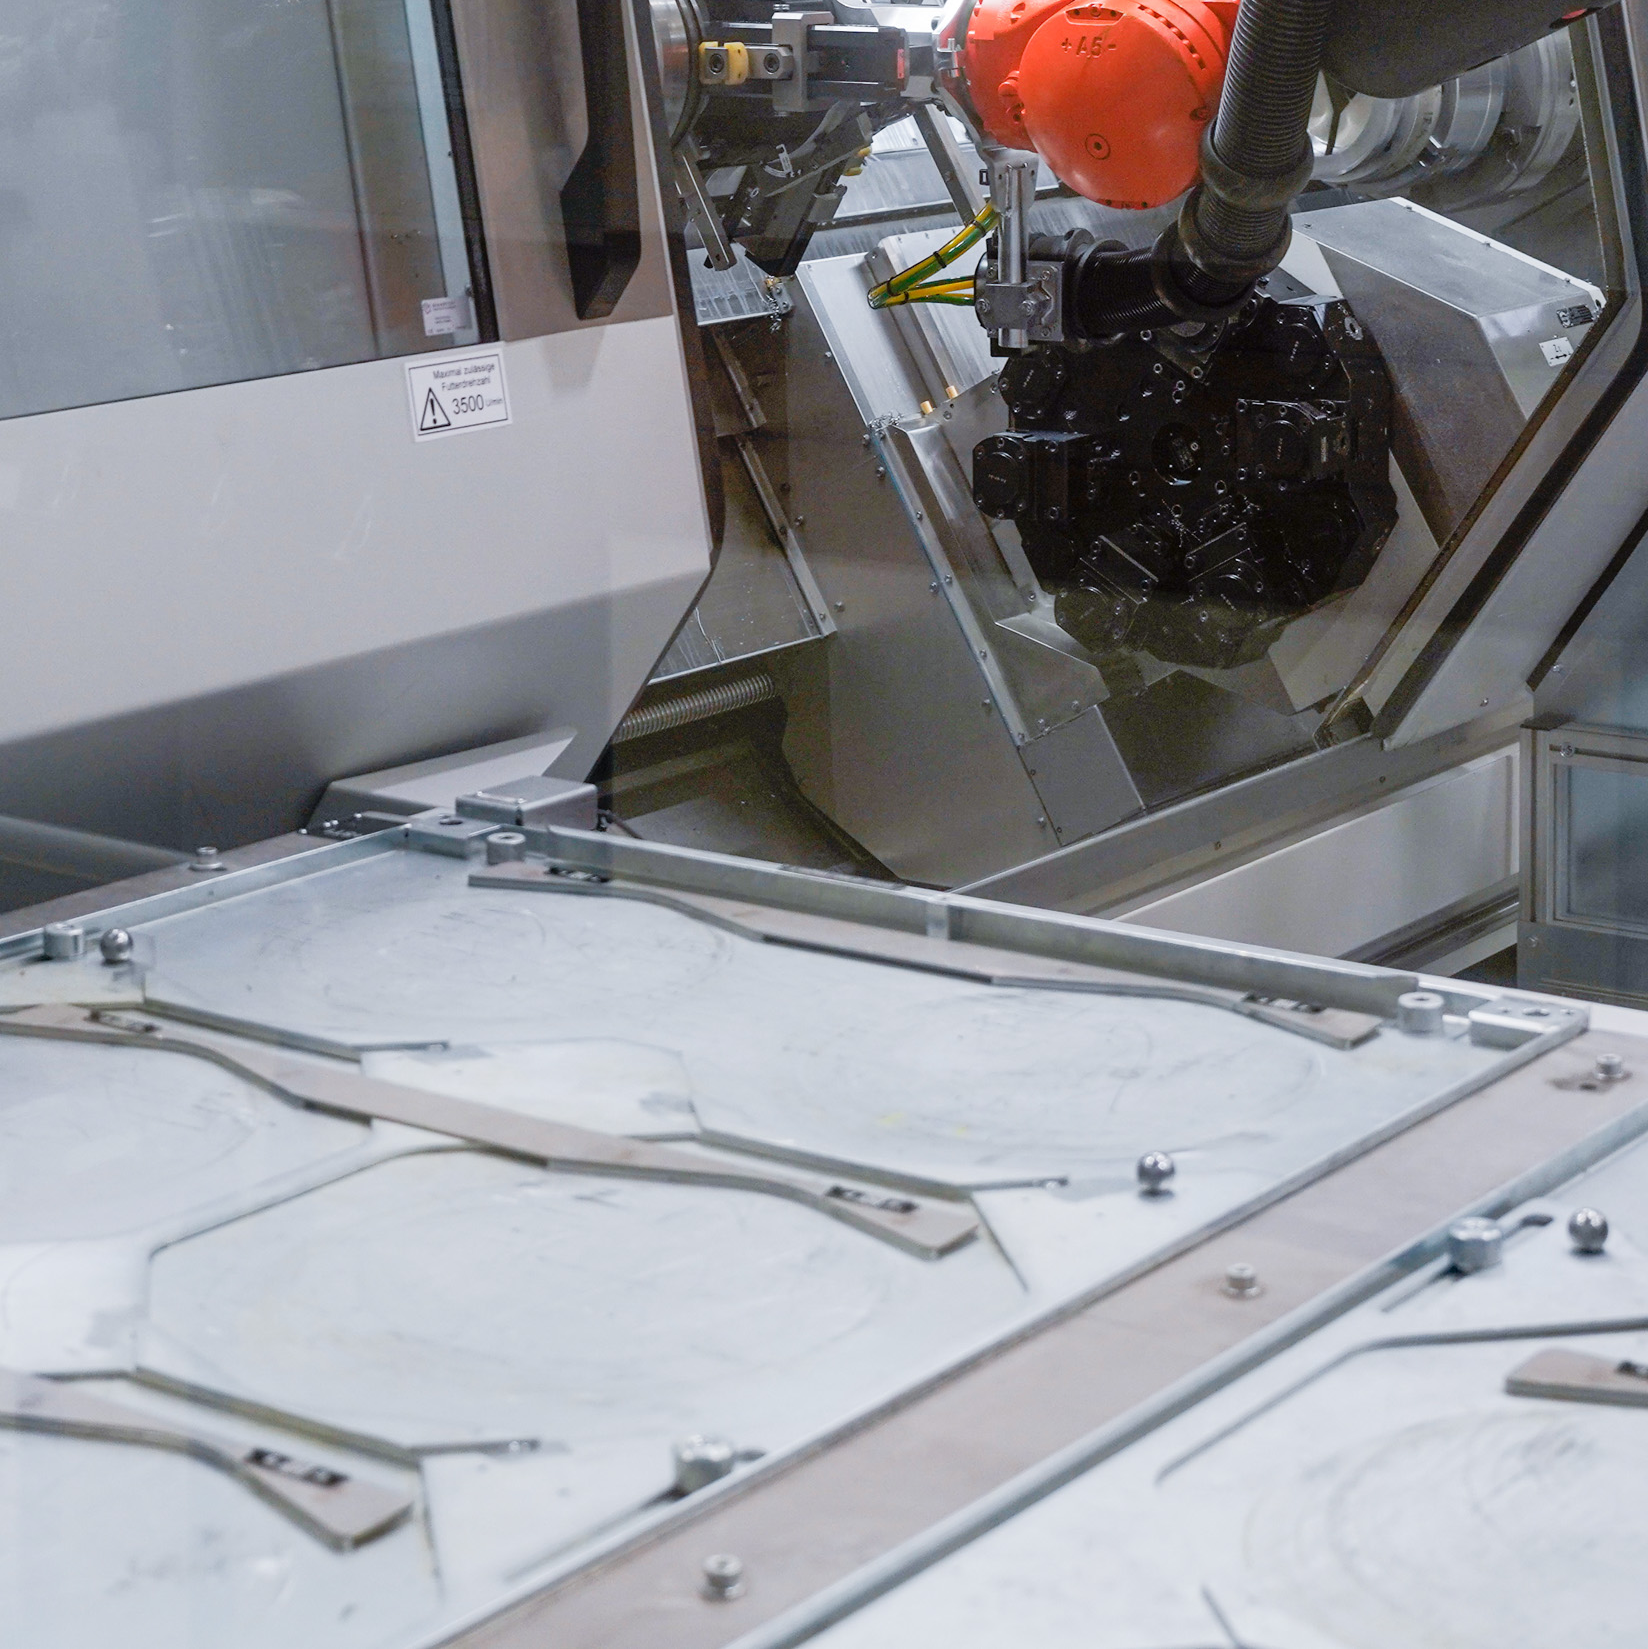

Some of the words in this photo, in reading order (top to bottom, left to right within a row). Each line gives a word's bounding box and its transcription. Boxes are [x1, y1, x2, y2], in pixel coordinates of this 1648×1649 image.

[433, 367, 462, 380] Maximal
[463, 362, 496, 375] zulässige
[441, 376, 491, 392] Futterdrehzahl
[451, 394, 484, 415] 3500
